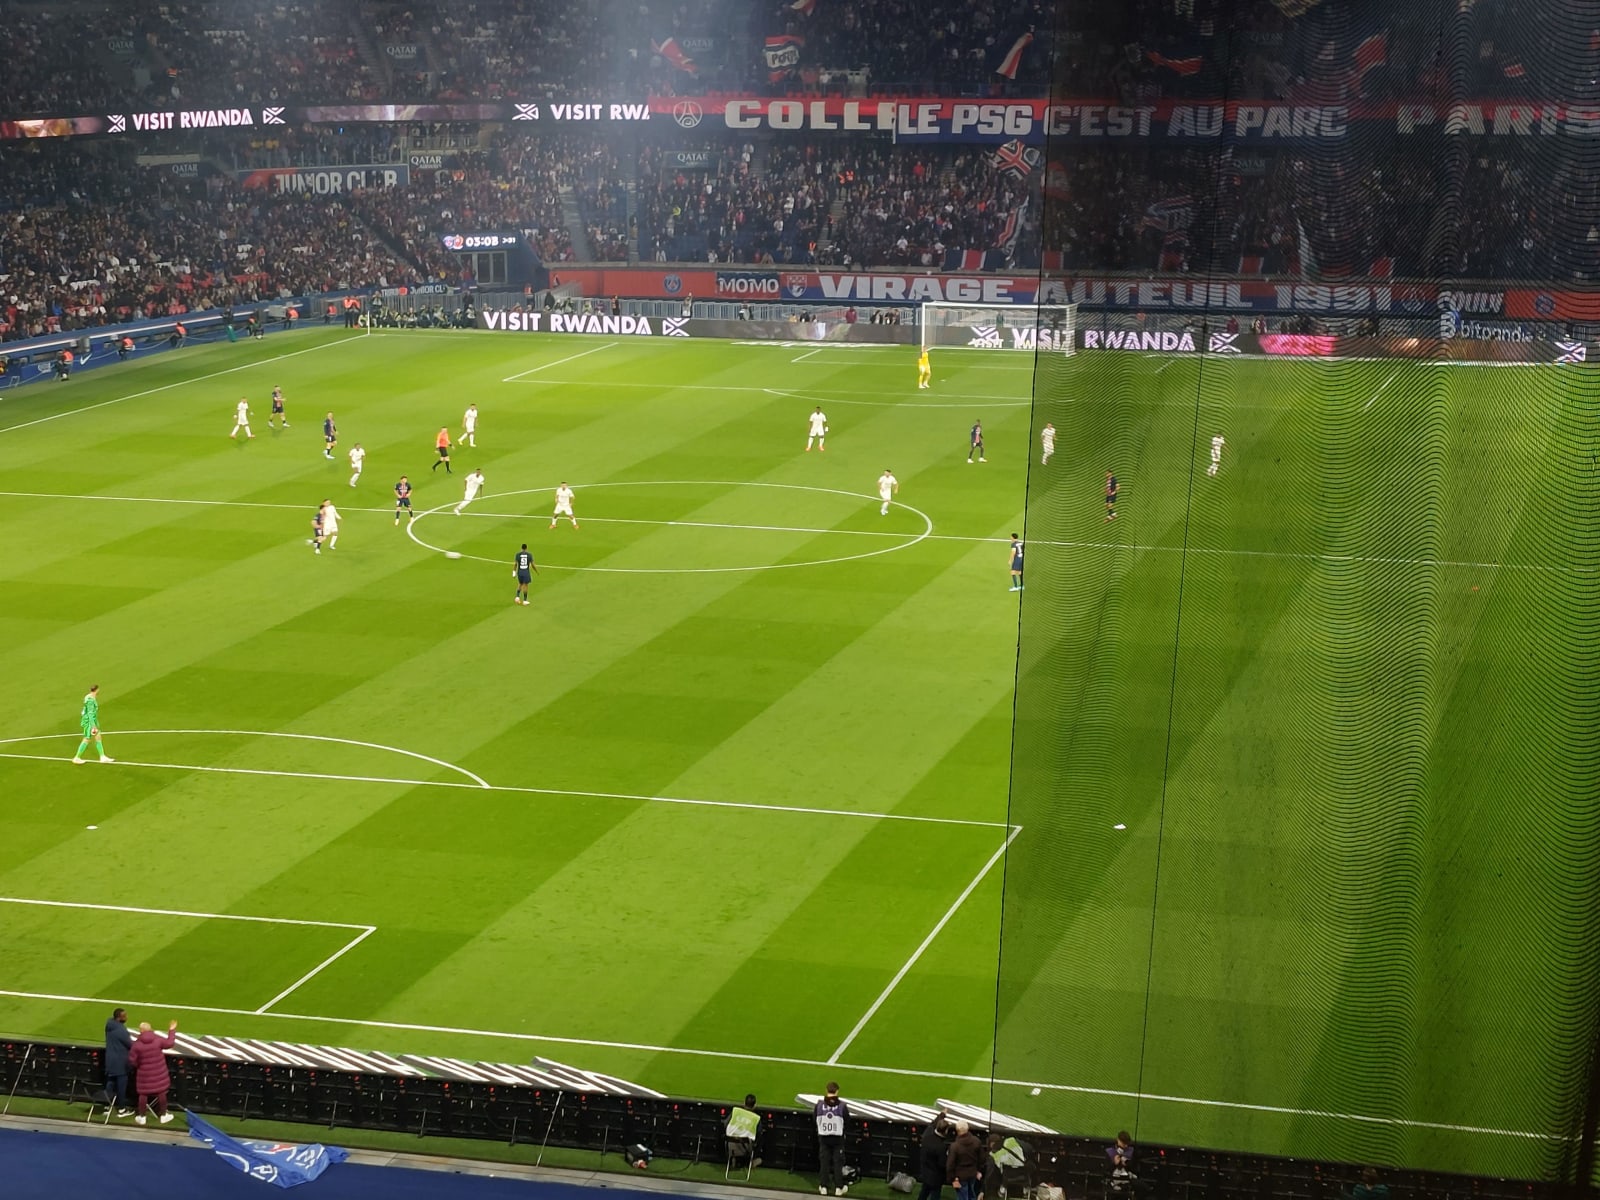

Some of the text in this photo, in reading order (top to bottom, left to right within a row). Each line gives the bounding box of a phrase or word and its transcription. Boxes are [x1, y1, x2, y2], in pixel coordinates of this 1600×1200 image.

[132, 108, 254, 131] VISIT RWANDA
[550, 103, 603, 121] VISIT
[898, 104, 1350, 137] LE PSG C'EST AU PARC
[171, 163, 199, 173] QATAR
[411, 155, 442, 166] QATAR
[677, 153, 710, 163] QATAR
[346, 169, 398, 192] CLB
[718, 278, 779, 294] MOMO
[818, 275, 1392, 311] VIRAGE AUTEUIL 1991
[483, 311, 653, 335] VISIT RWANDA
[1083, 330, 1197, 352] RWANDA
